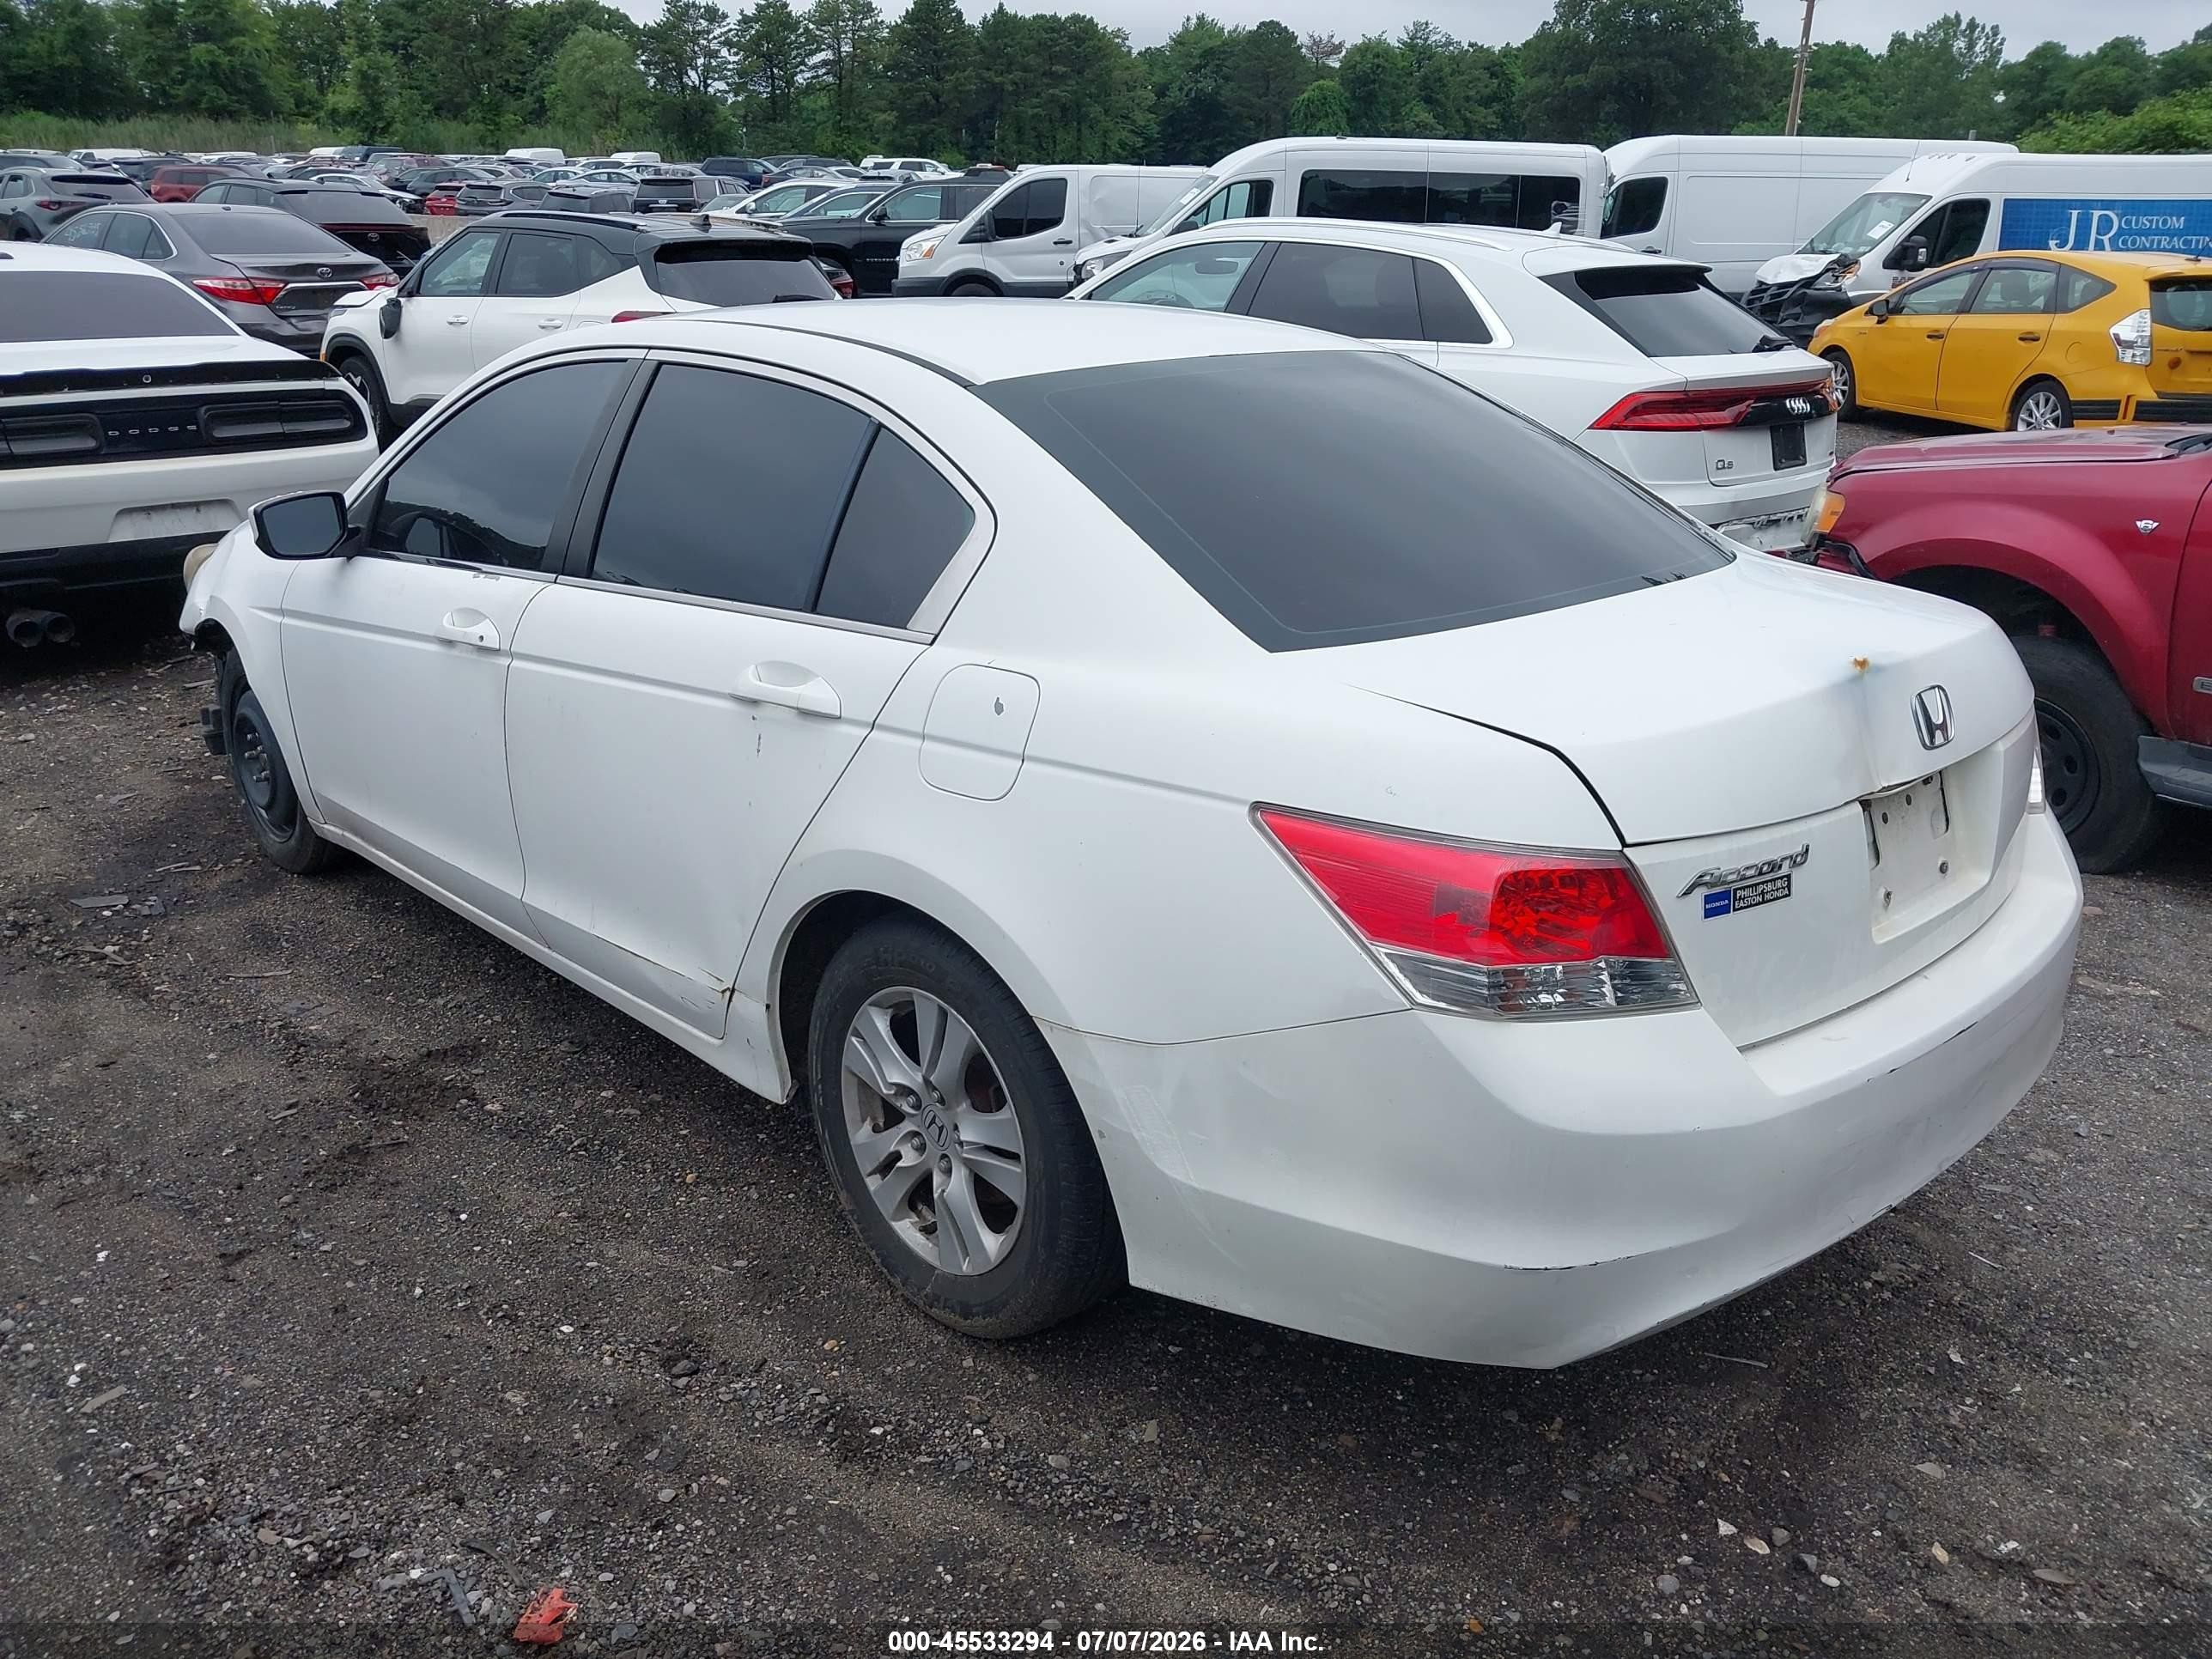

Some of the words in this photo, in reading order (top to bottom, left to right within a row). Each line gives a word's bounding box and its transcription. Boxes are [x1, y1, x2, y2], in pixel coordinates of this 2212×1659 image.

[2048, 210, 2119, 252] JR
[2121, 216, 2185, 230] CUSTOM
[107, 424, 197, 436] DODGE
[1675, 842, 1810, 898] Accord
[1735, 894, 1763, 908] EASTON
[1764, 887, 1790, 901] HONDA
[1736, 878, 1788, 899] PHILLIPSBURG
[1705, 899, 1729, 909] HONDA
